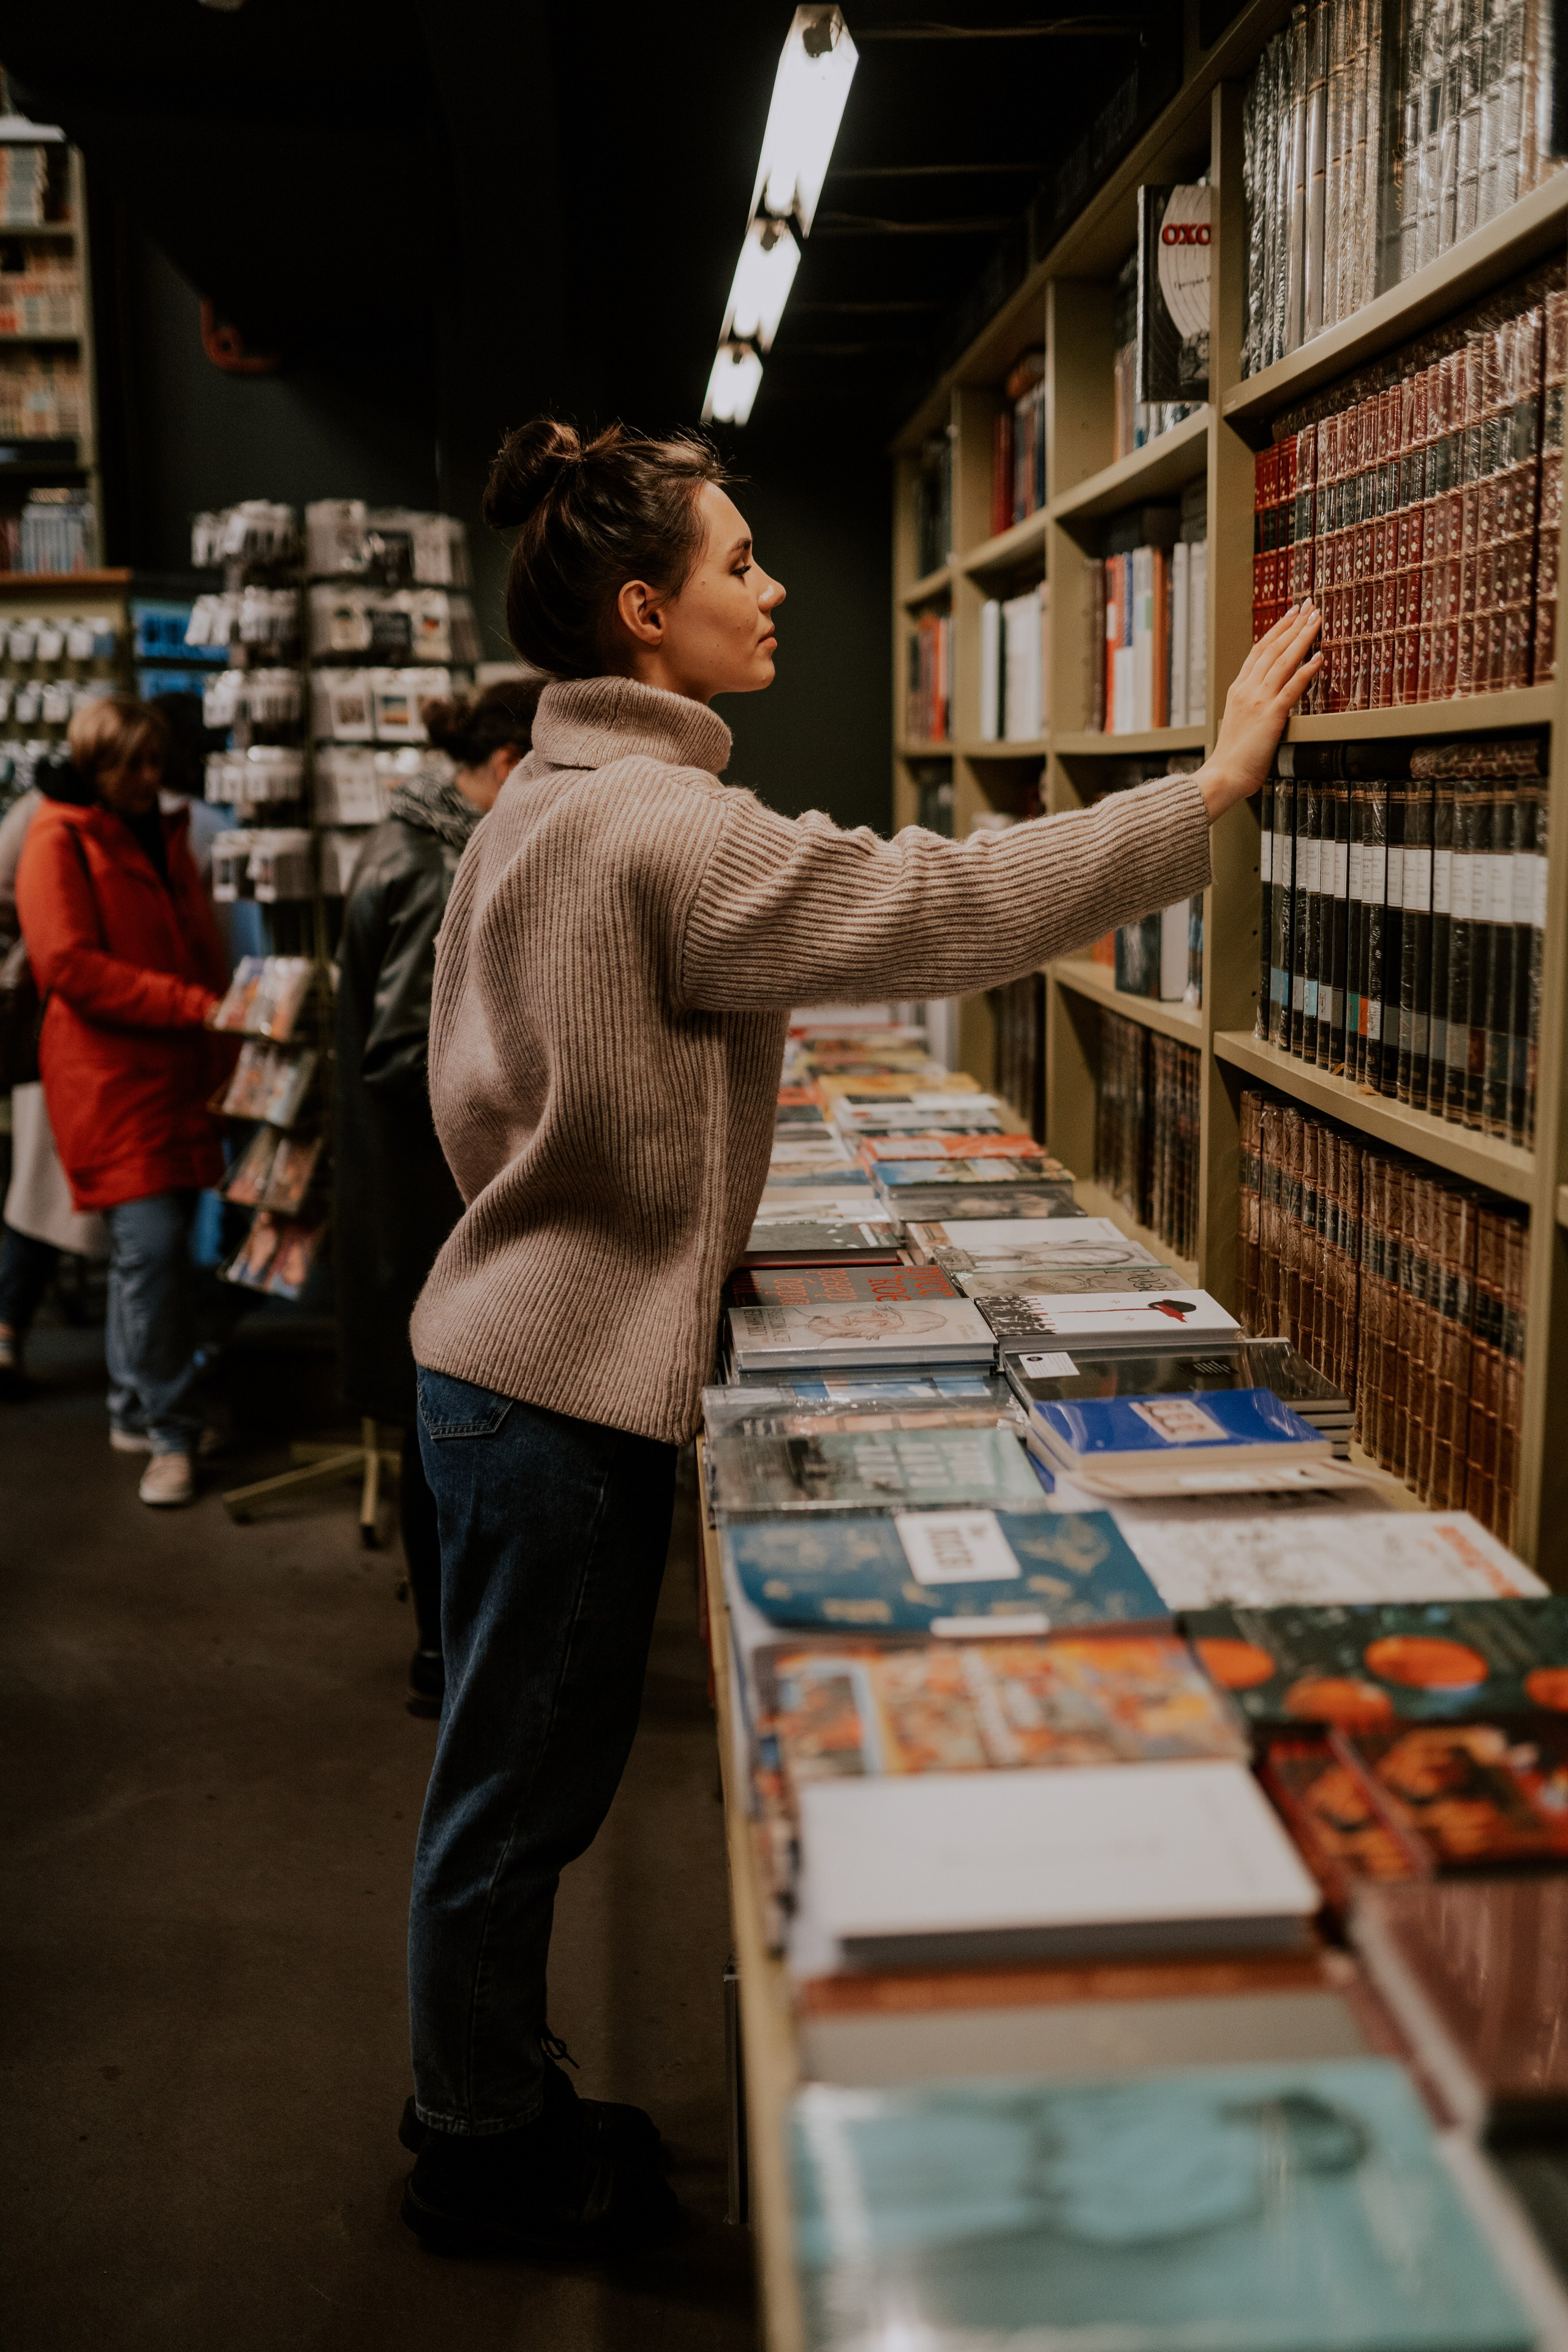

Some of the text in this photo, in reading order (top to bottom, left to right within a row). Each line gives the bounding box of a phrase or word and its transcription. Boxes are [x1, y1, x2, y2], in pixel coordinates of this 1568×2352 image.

[764, 1278, 817, 1306] бера
[805, 1270, 859, 1301] ревер
[867, 1278, 911, 1302] кое
[892, 1266, 955, 1296] русс
